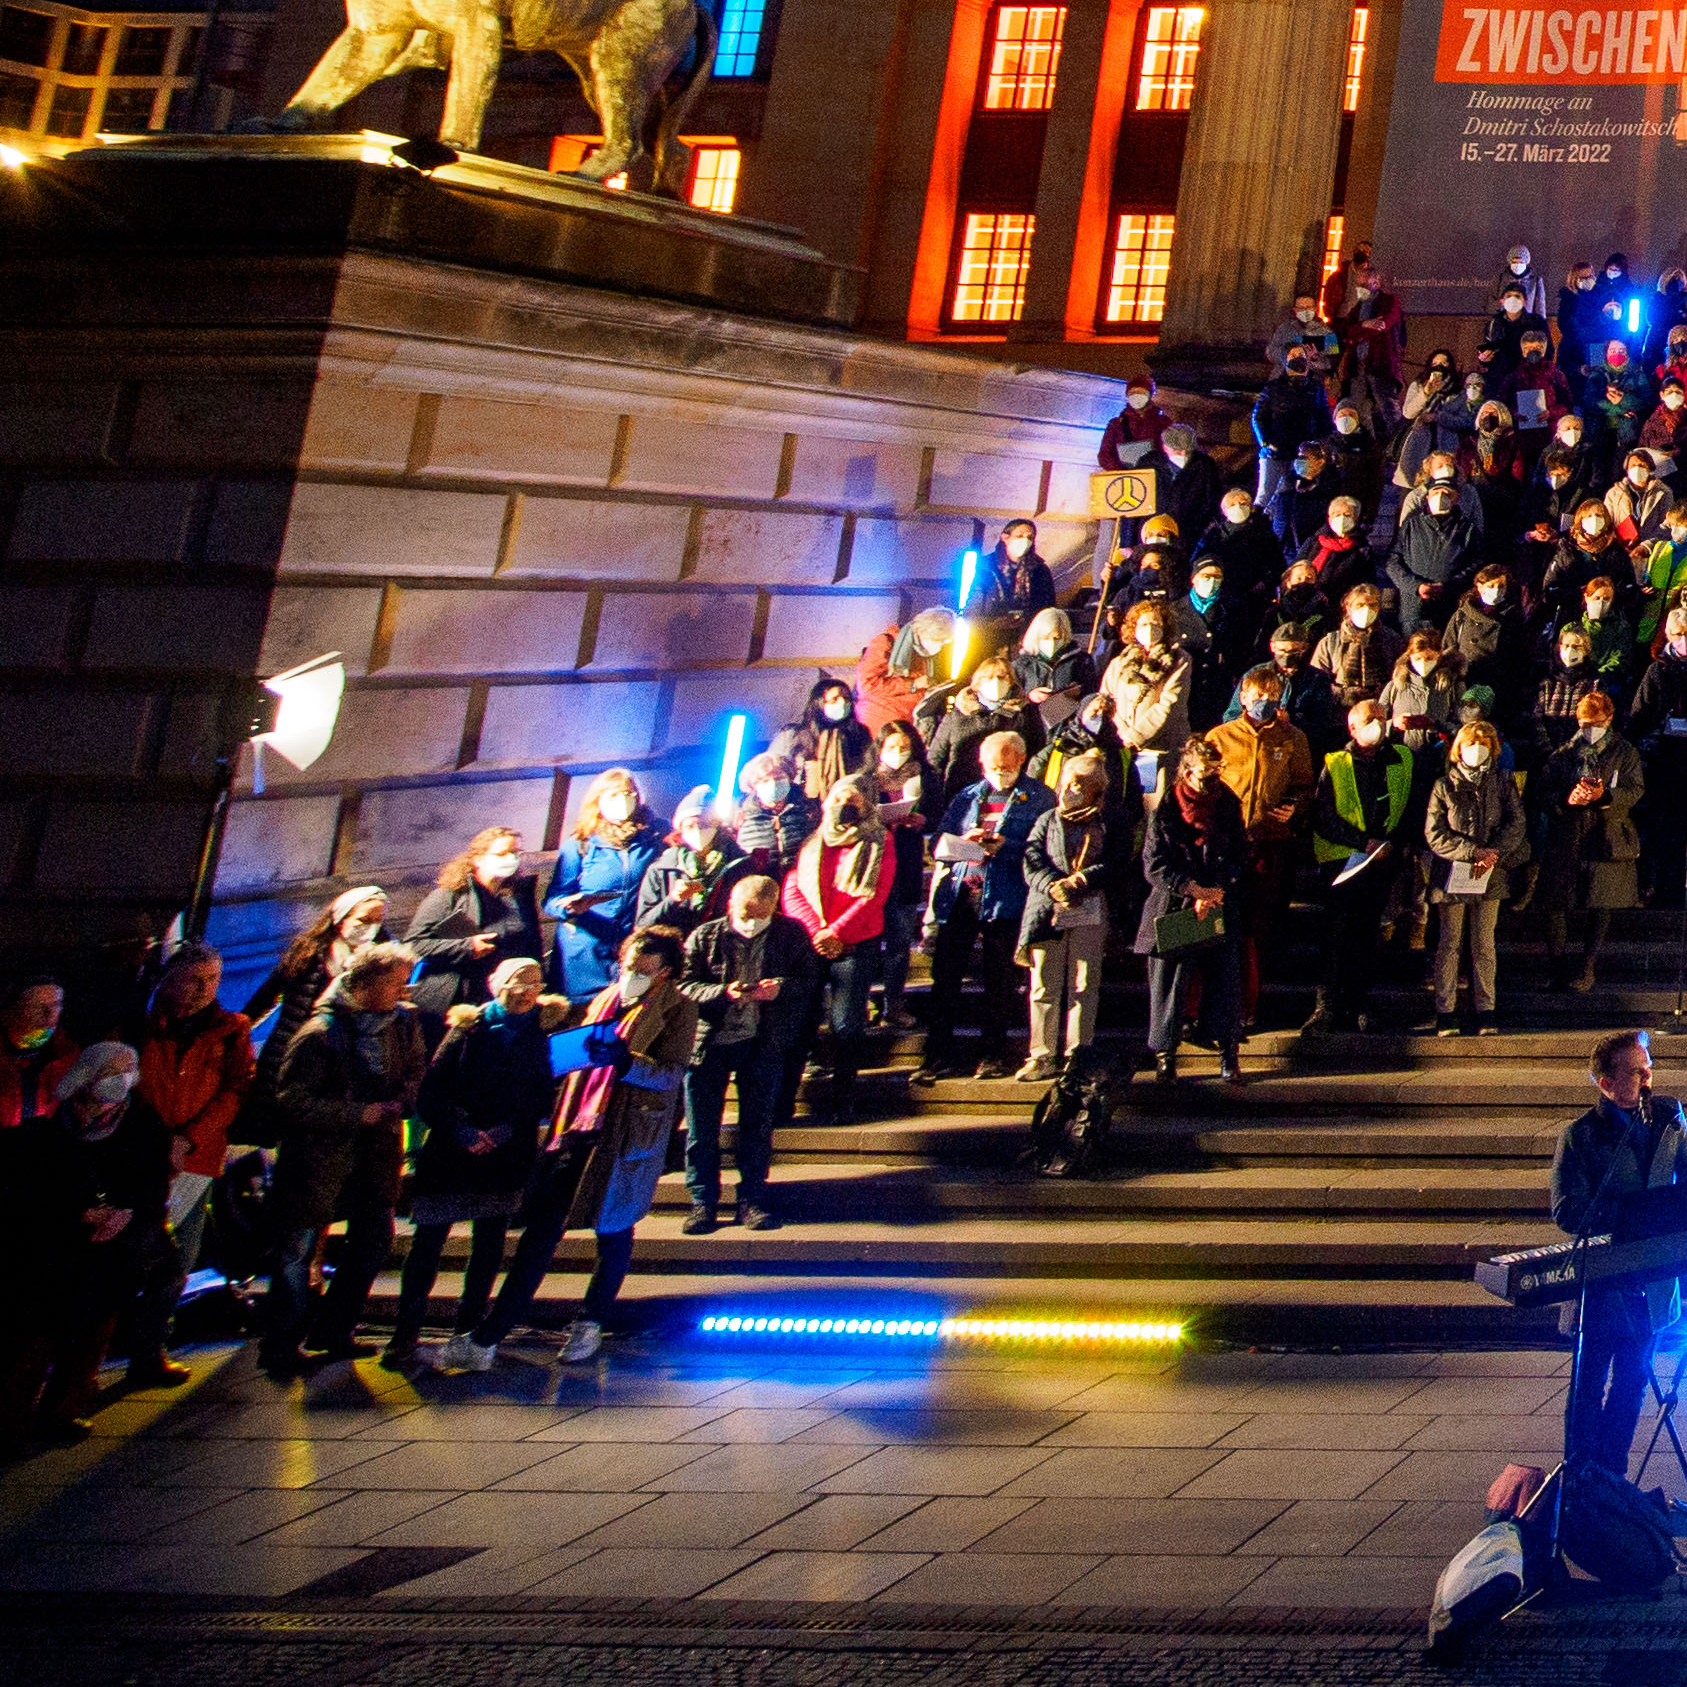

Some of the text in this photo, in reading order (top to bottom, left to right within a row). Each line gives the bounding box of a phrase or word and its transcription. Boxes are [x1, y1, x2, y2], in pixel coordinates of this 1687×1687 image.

[1466, 90, 1593, 115] Hommage an
[1463, 116, 1679, 138] Dmitri Schostakowitsch
[1523, 143, 1564, 163] März
[1567, 143, 1612, 163] 2022
